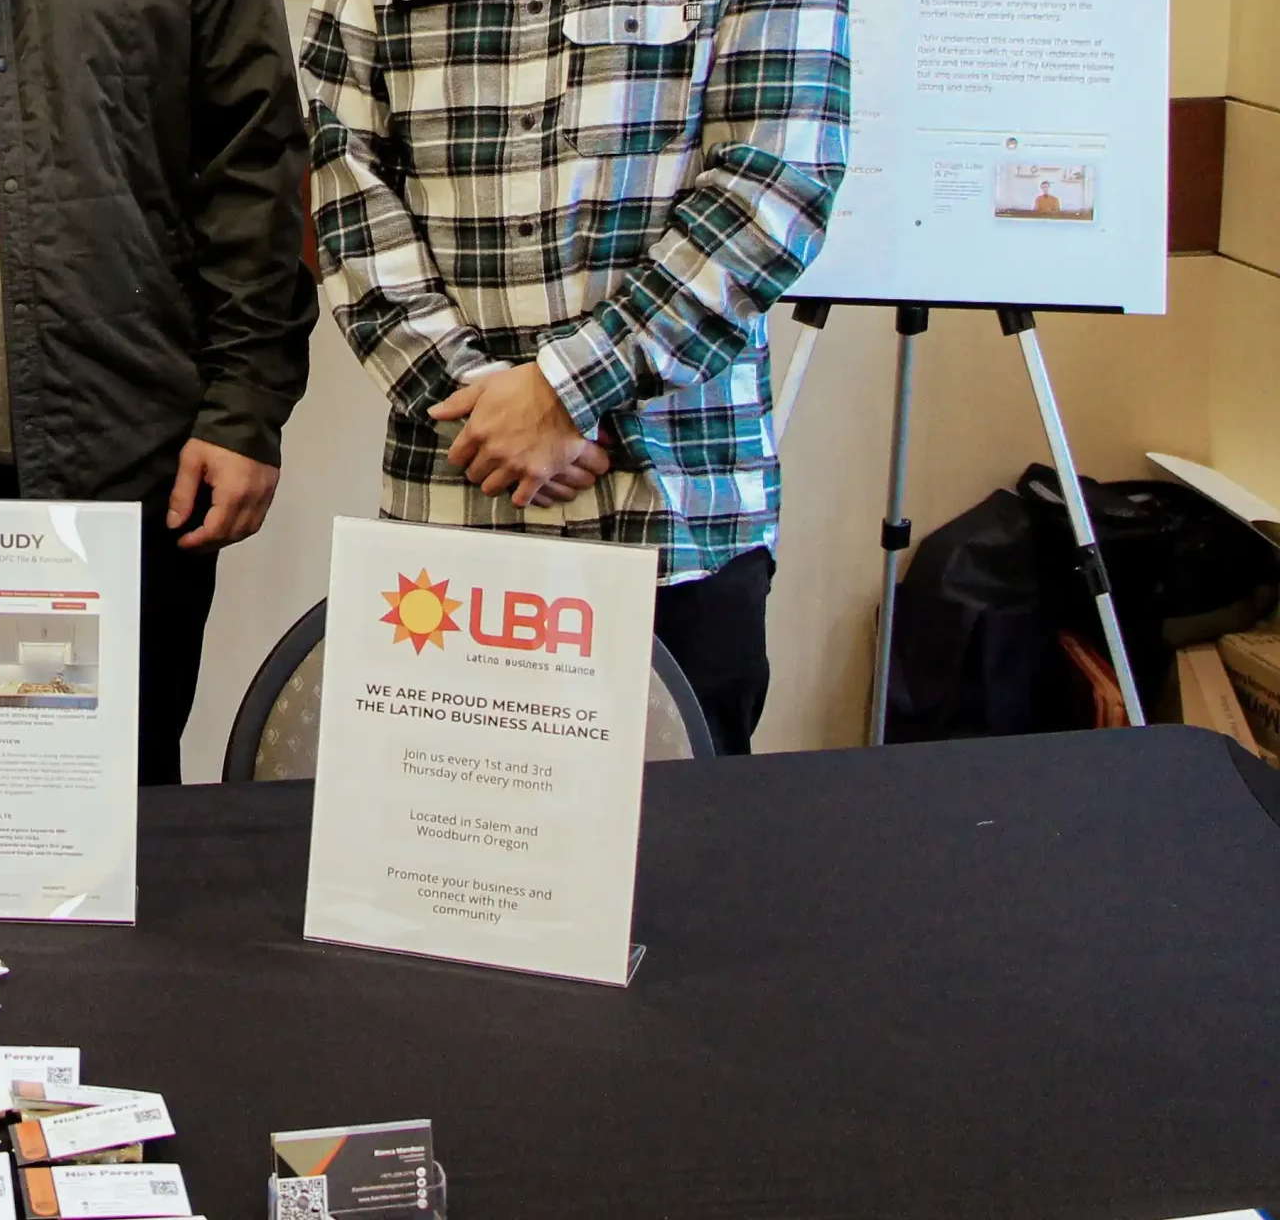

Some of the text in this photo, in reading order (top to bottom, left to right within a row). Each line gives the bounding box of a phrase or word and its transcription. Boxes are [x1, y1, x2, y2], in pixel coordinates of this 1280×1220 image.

[470, 587, 593, 657] LBA
[466, 654, 498, 664] Latino
[366, 684, 596, 721] WE ARE PROUD MEMBERS OF
[356, 699, 608, 740] THE LATINO BUSINESS ALLIANCE
[403, 748, 552, 776] Join us every 1st and 3rd
[402, 762, 552, 791] Thursday of every month
[410, 810, 537, 836] Located in Salem and
[417, 826, 528, 850] Woodburn Oregon
[387, 867, 551, 900] Promote your business and
[418, 888, 517, 910] connect with the
[432, 905, 500, 924] community
